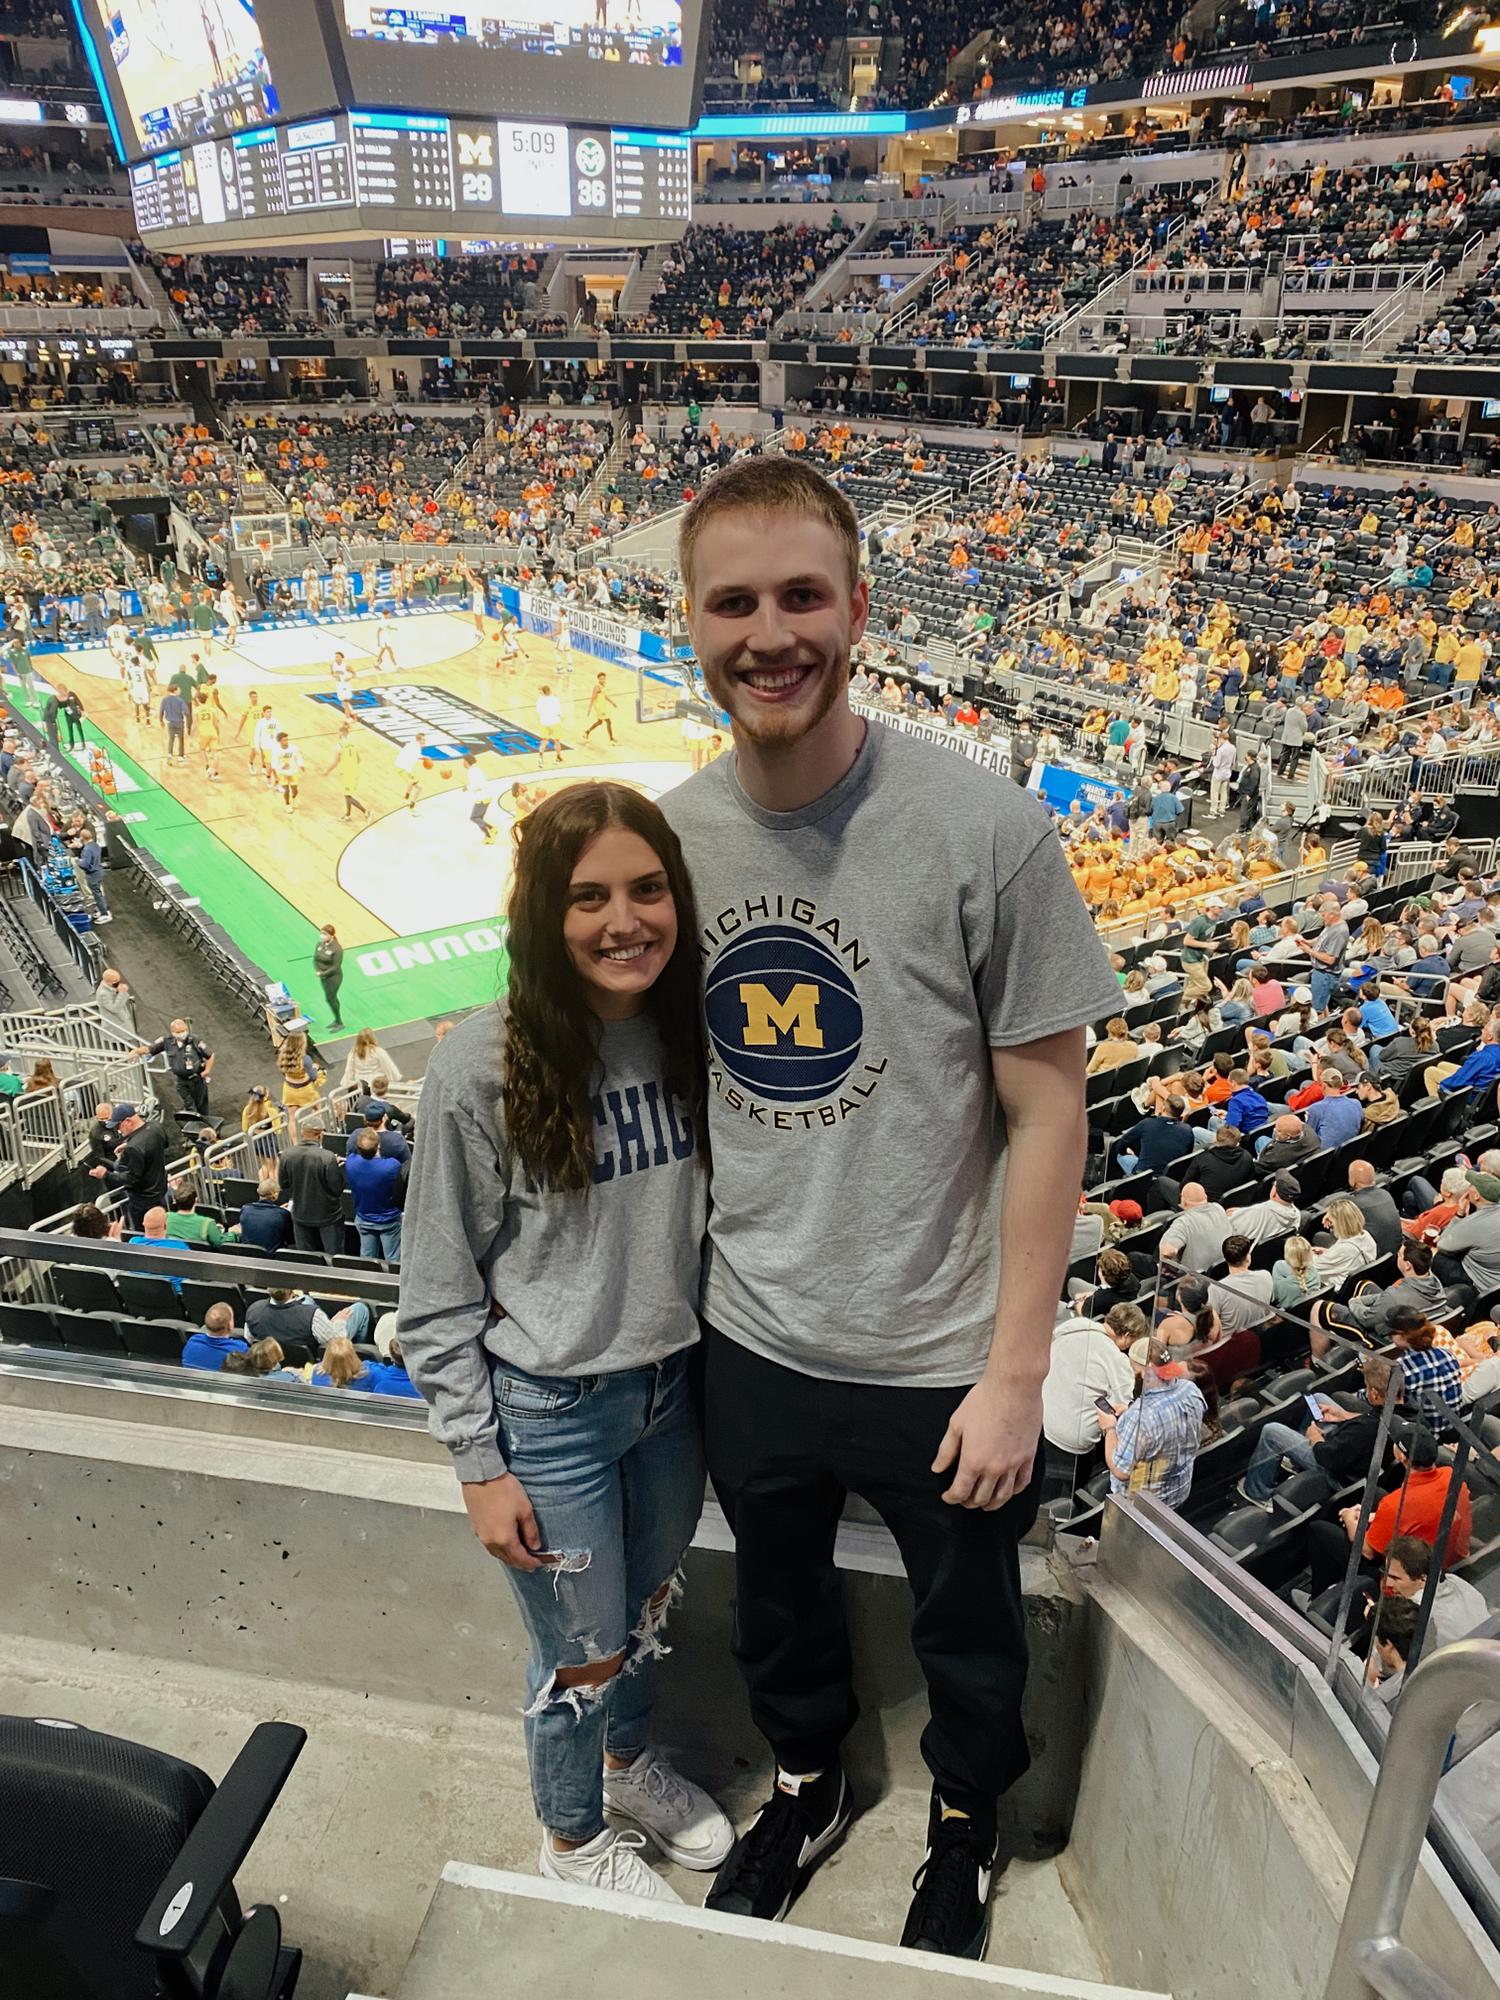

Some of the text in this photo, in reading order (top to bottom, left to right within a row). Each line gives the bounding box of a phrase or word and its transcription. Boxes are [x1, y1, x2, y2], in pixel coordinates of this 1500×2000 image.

[64, 104, 88, 123] 36
[457, 133, 493, 167] M
[511, 130, 556, 155] 5:09
[462, 173, 493, 202] 29
[577, 180, 606, 207] 36
[257, 619, 312, 630] THE
[394, 604, 464, 616] FOUR
[530, 597, 553, 618] FIRST
[568, 609, 590, 632] COND
[591, 617, 627, 644] ROUNDS
[903, 721, 970, 756] HORIZON
[972, 746, 1011, 777] LEAG
[738, 982, 826, 1049] M
